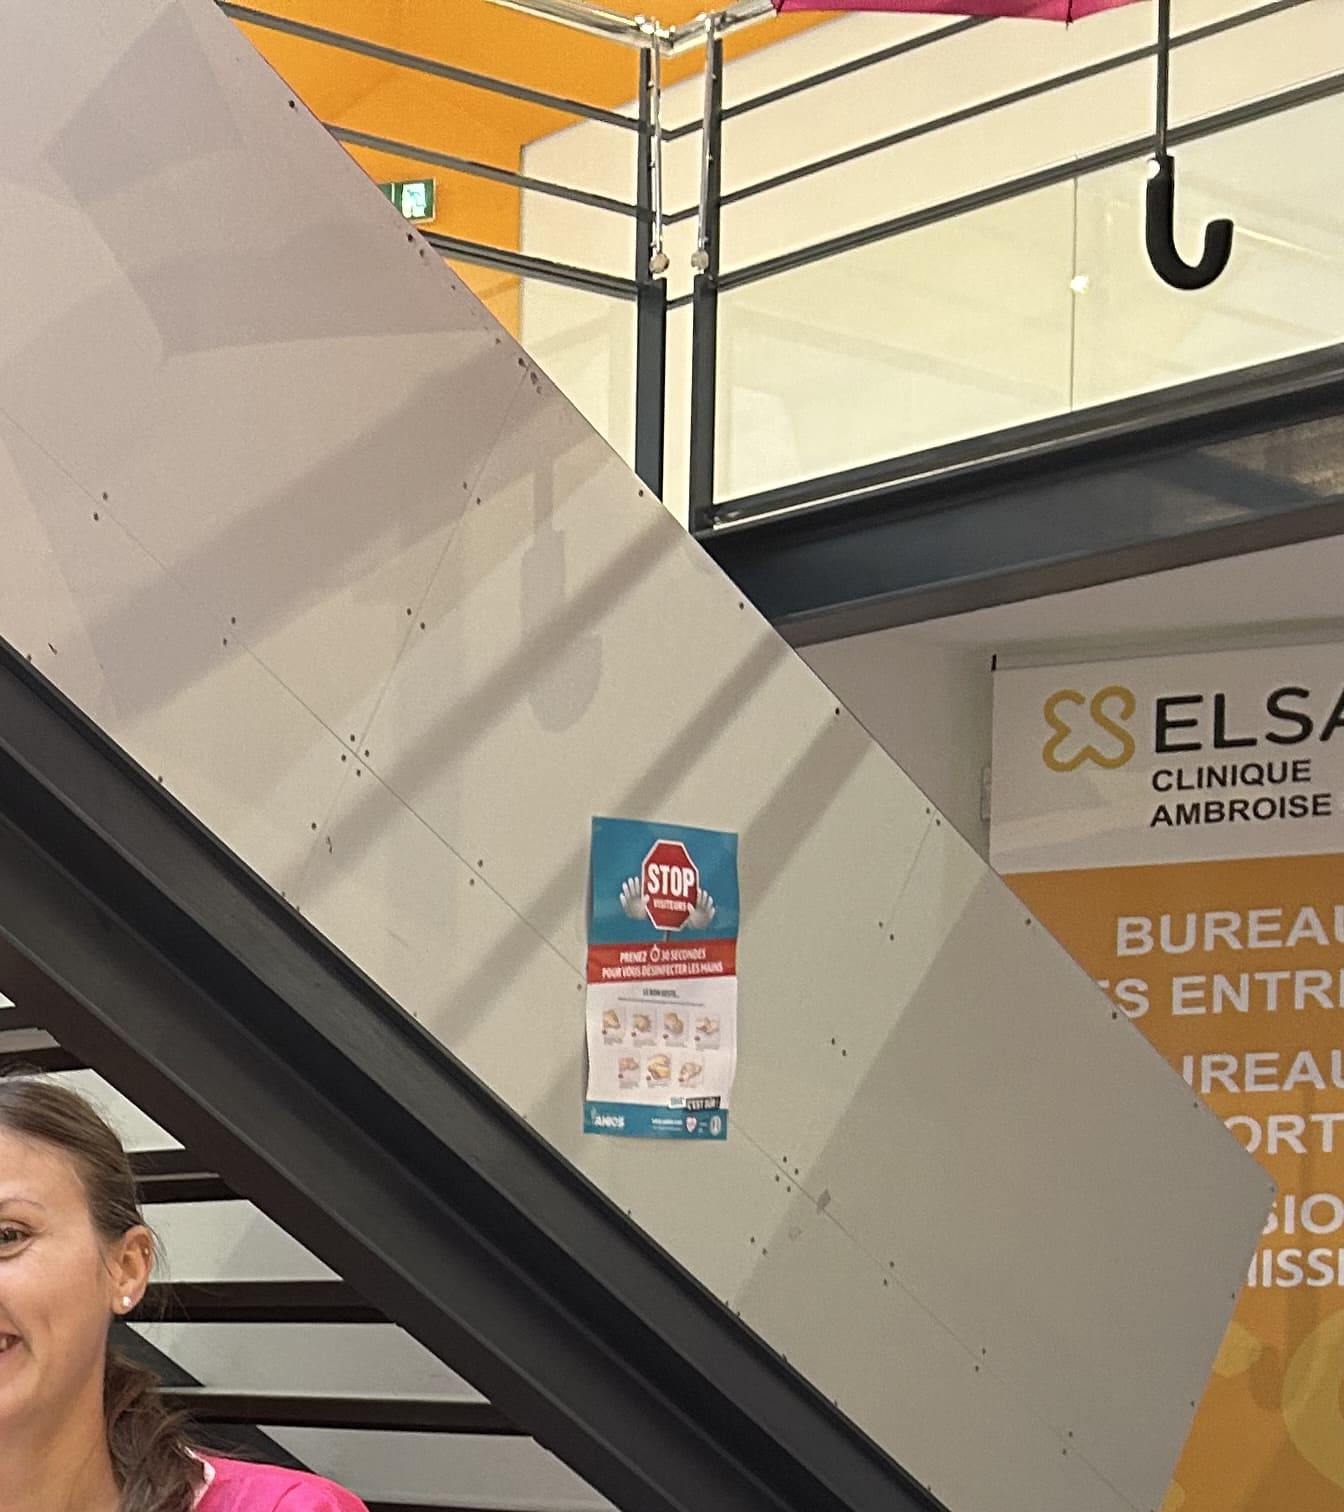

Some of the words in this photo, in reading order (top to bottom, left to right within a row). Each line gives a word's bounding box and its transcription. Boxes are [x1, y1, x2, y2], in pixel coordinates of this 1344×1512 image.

[1151, 758, 1312, 793] CLINIQUE
[1150, 793, 1333, 828] AMBROISE
[647, 862, 695, 897] STOP
[1116, 904, 1344, 957] BUREA
[1172, 968, 1344, 1016] ENTR
